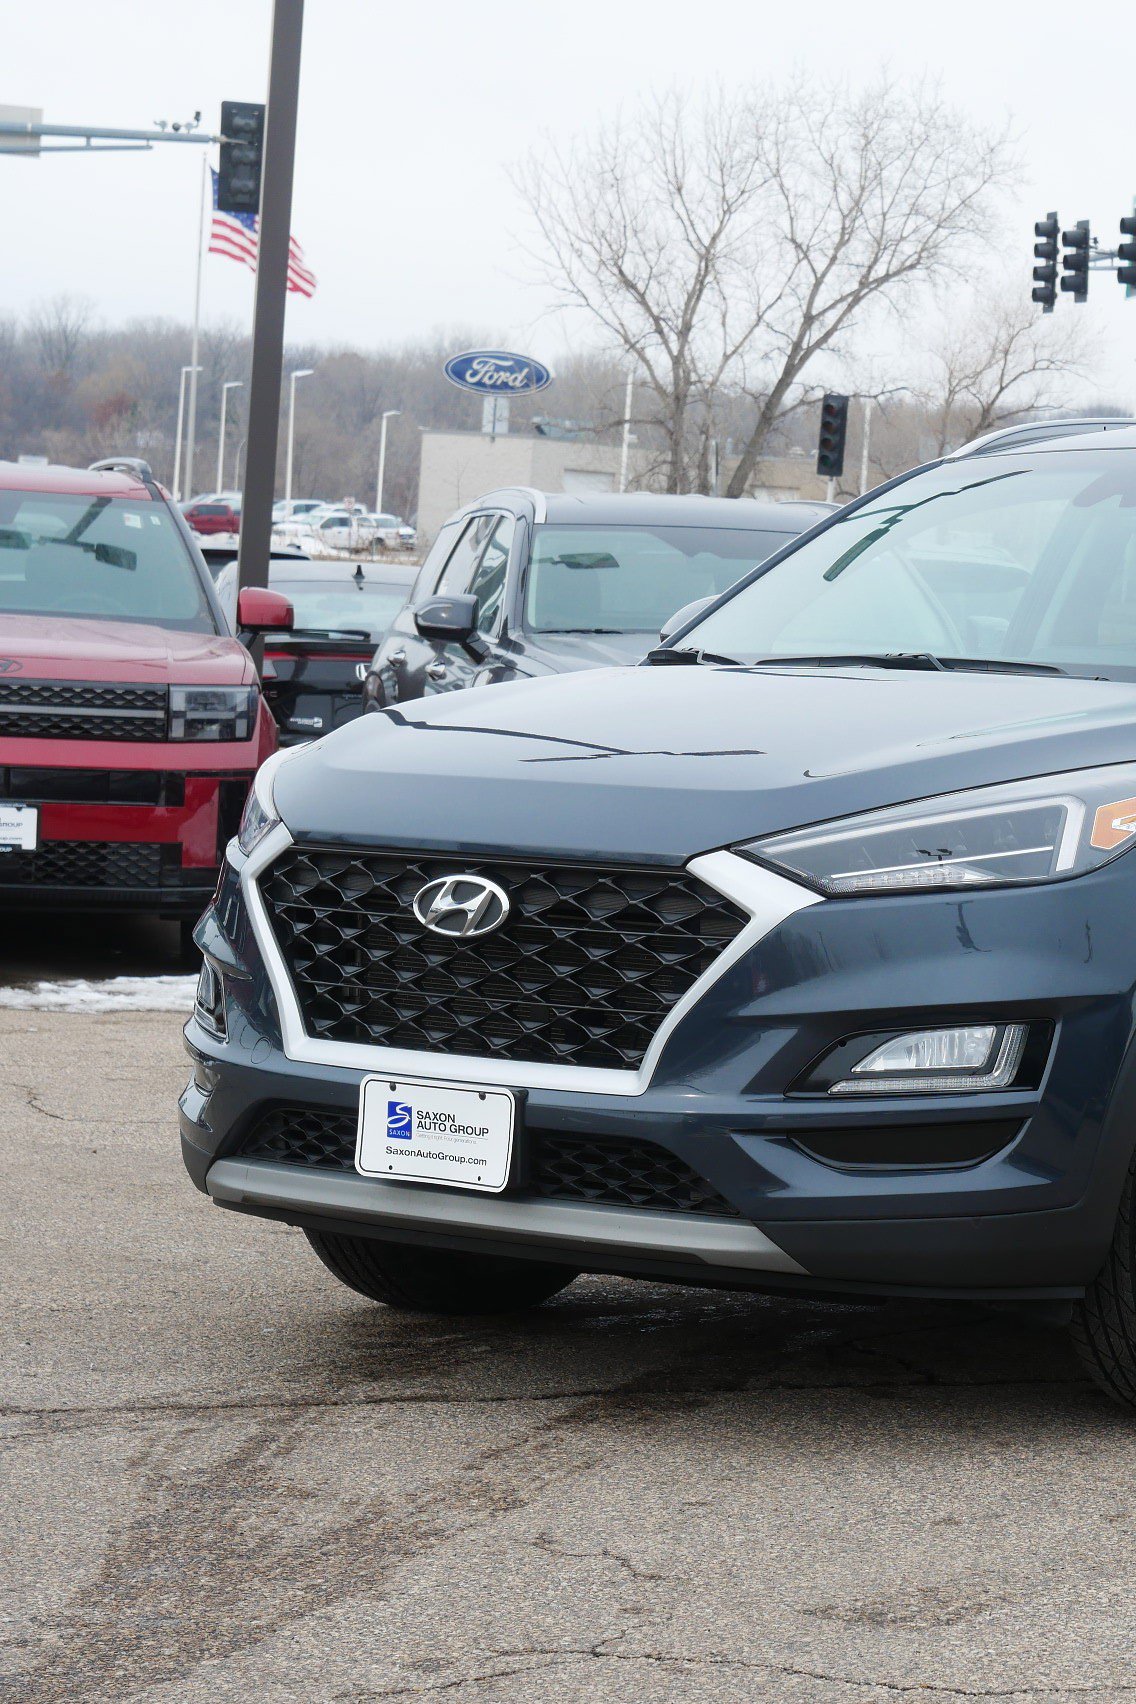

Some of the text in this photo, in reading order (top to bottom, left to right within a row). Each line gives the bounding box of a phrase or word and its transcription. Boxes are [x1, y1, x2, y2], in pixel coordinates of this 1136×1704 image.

[465, 357, 529, 388] Ford
[416, 1110, 456, 1124] SAXON
[389, 1129, 410, 1137] SAXON
[416, 1120, 489, 1137] AUTO GROUP
[385, 1145, 487, 1166] SaxonAutoGroup.com
